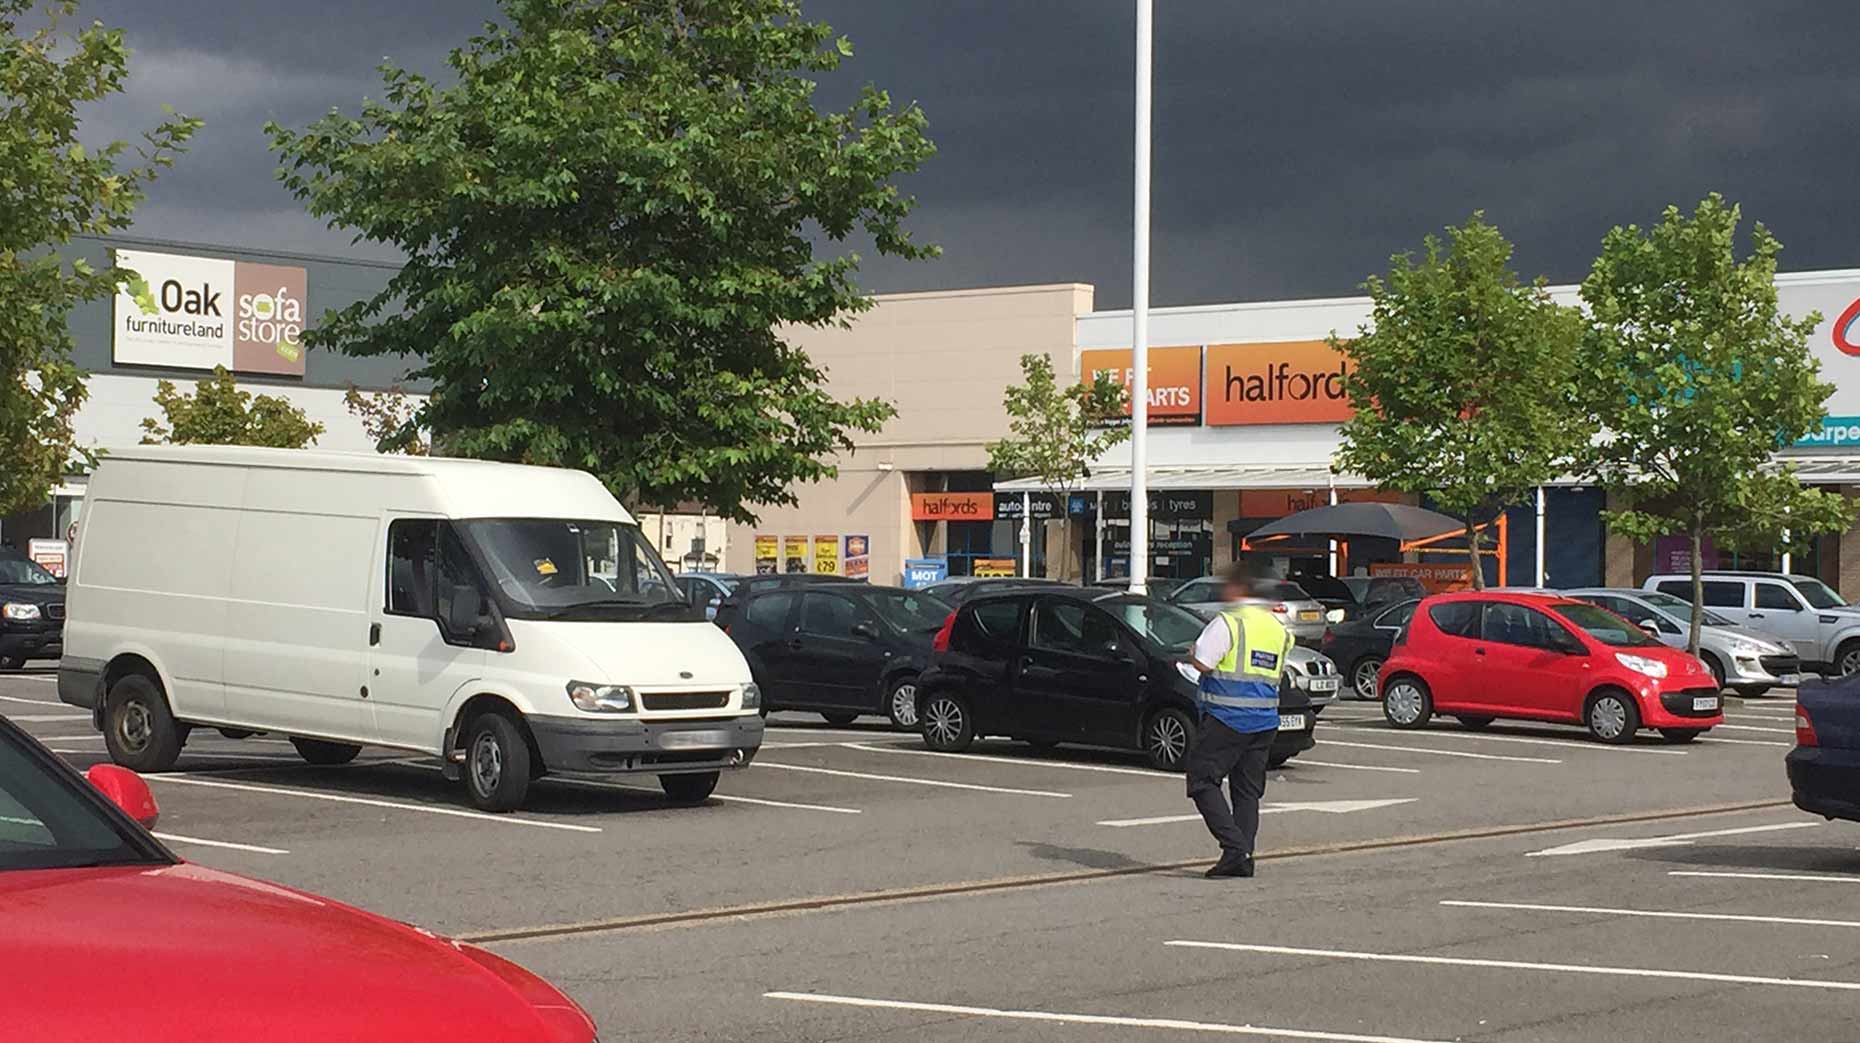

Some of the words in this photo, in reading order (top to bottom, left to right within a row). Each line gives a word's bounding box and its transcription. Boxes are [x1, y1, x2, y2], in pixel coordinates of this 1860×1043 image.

[161, 279, 221, 317] Oak
[238, 286, 302, 322] sofa
[126, 315, 224, 339] furnitureland
[238, 317, 301, 345] store
[1225, 361, 1354, 402] halford
[1146, 387, 1190, 407] ARTS
[923, 499, 978, 515] halfords
[998, 501, 1052, 512] autontre
[1089, 501, 1108, 510] MT
[1169, 499, 1197, 512] tyres
[911, 571, 938, 581] MOT
[1410, 569, 1432, 579] CAR
[1434, 569, 1467, 581] PARTS
